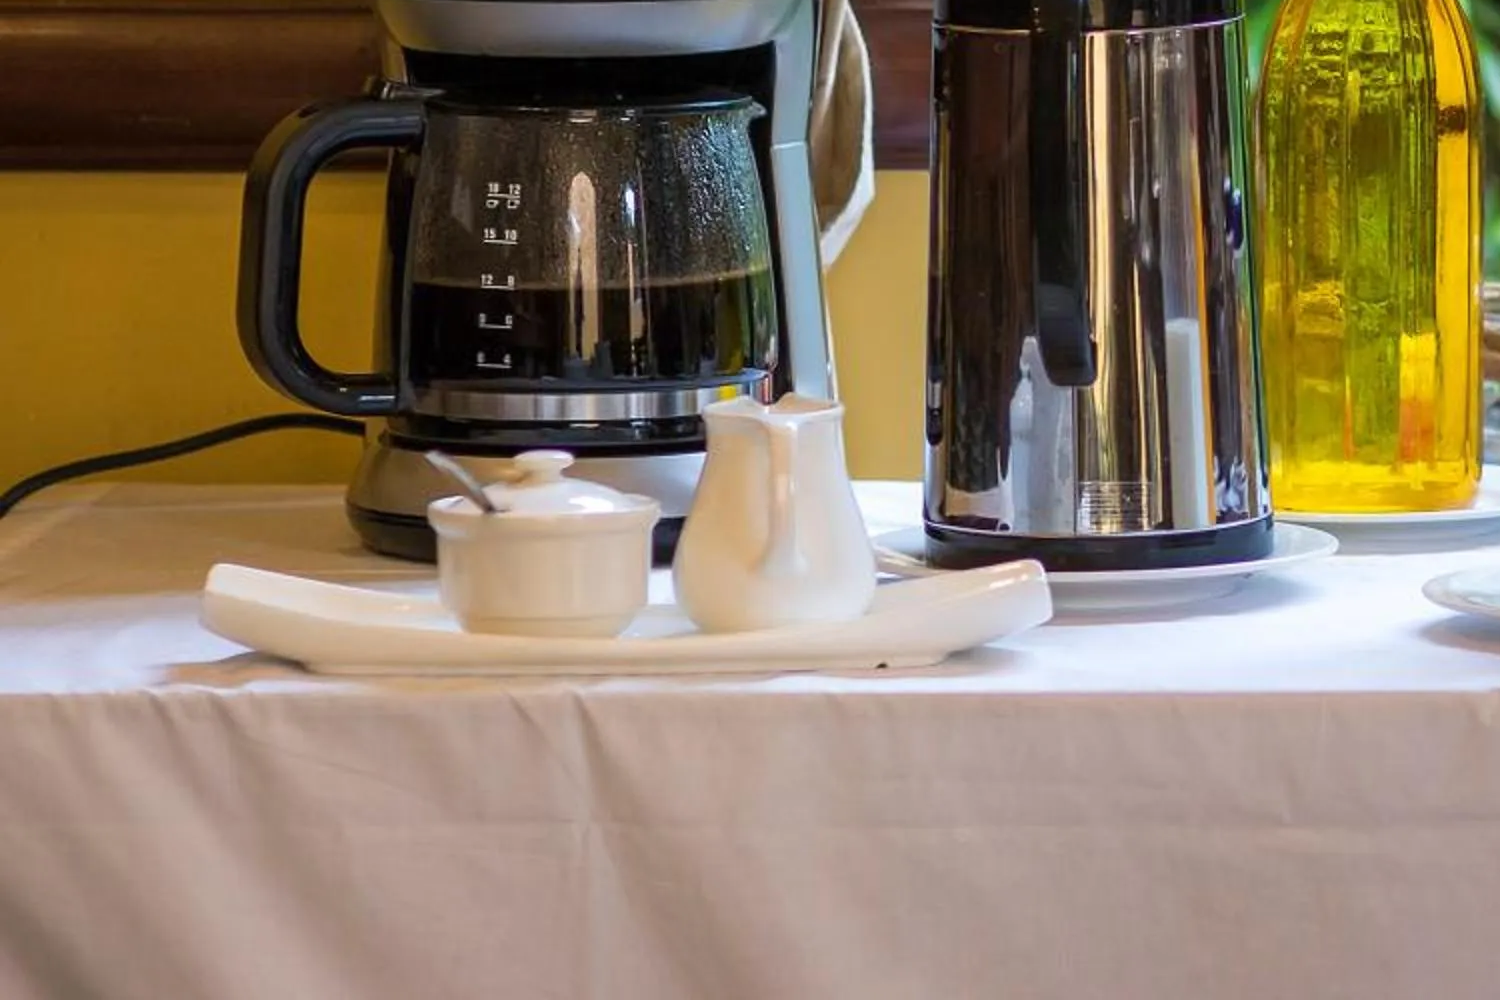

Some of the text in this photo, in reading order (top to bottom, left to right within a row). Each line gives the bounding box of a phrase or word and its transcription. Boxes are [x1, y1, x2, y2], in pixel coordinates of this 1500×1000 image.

[508, 183, 521, 195] 12
[483, 227, 517, 241] 15 10
[481, 273, 494, 285] 12
